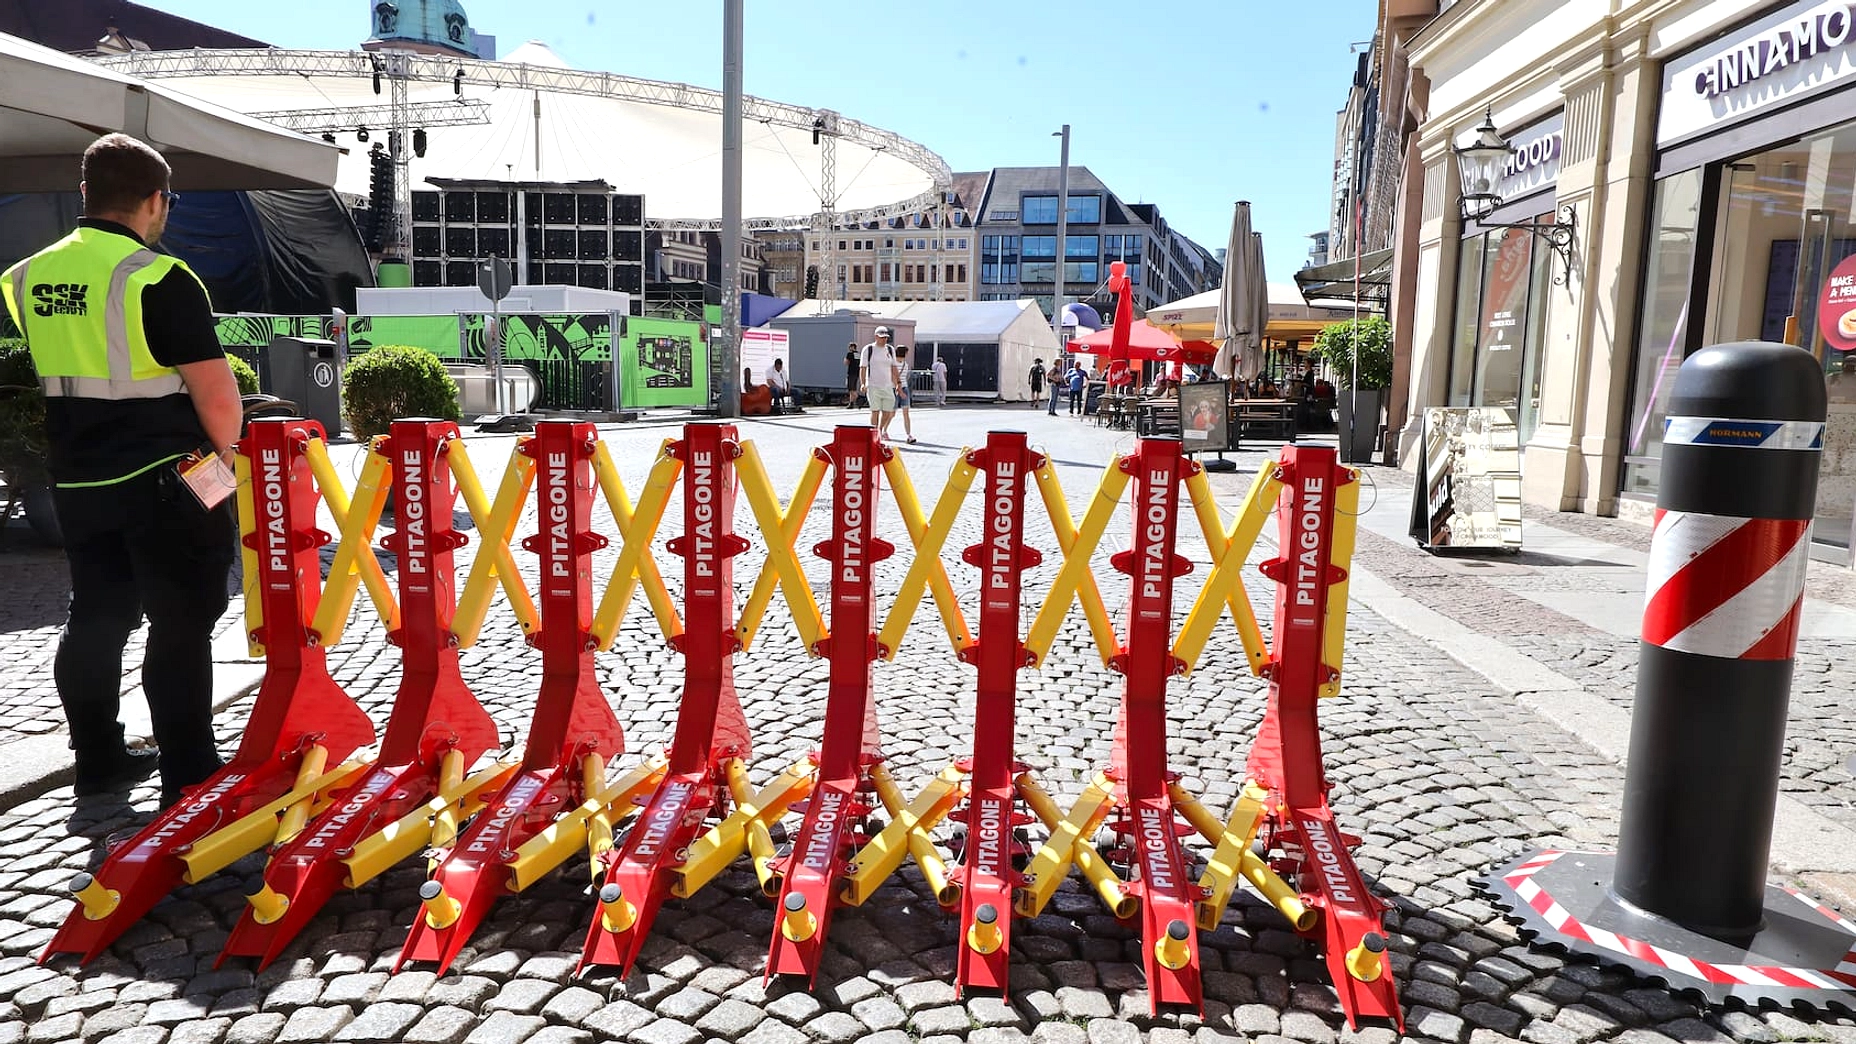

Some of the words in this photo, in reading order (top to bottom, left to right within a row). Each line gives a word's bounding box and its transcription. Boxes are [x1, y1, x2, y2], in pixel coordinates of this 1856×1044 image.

[1693, 3, 1852, 100] CINNAMO
[1831, 275, 1854, 287] MAKE
[261, 448, 288, 571] PITAGONE
[403, 450, 426, 573] PITAGONE
[550, 451, 569, 577] PITAGONE
[694, 451, 714, 577] PITAGONE
[842, 456, 863, 583] PITAGONE
[992, 461, 1015, 589] PITAGONE
[1143, 470, 1169, 599] PITAGONE
[1296, 477, 1323, 606] PITAGONE
[149, 773, 246, 846] PITAGONE
[305, 773, 392, 848] PITAGONE
[467, 776, 543, 853] PITAGONE
[634, 782, 691, 856] PITAGONE
[802, 792, 842, 868] PITAGONE
[977, 799, 1000, 877] PITAGONE
[1140, 807, 1174, 889] PITAGONE
[1301, 819, 1356, 903] PITAGONE
